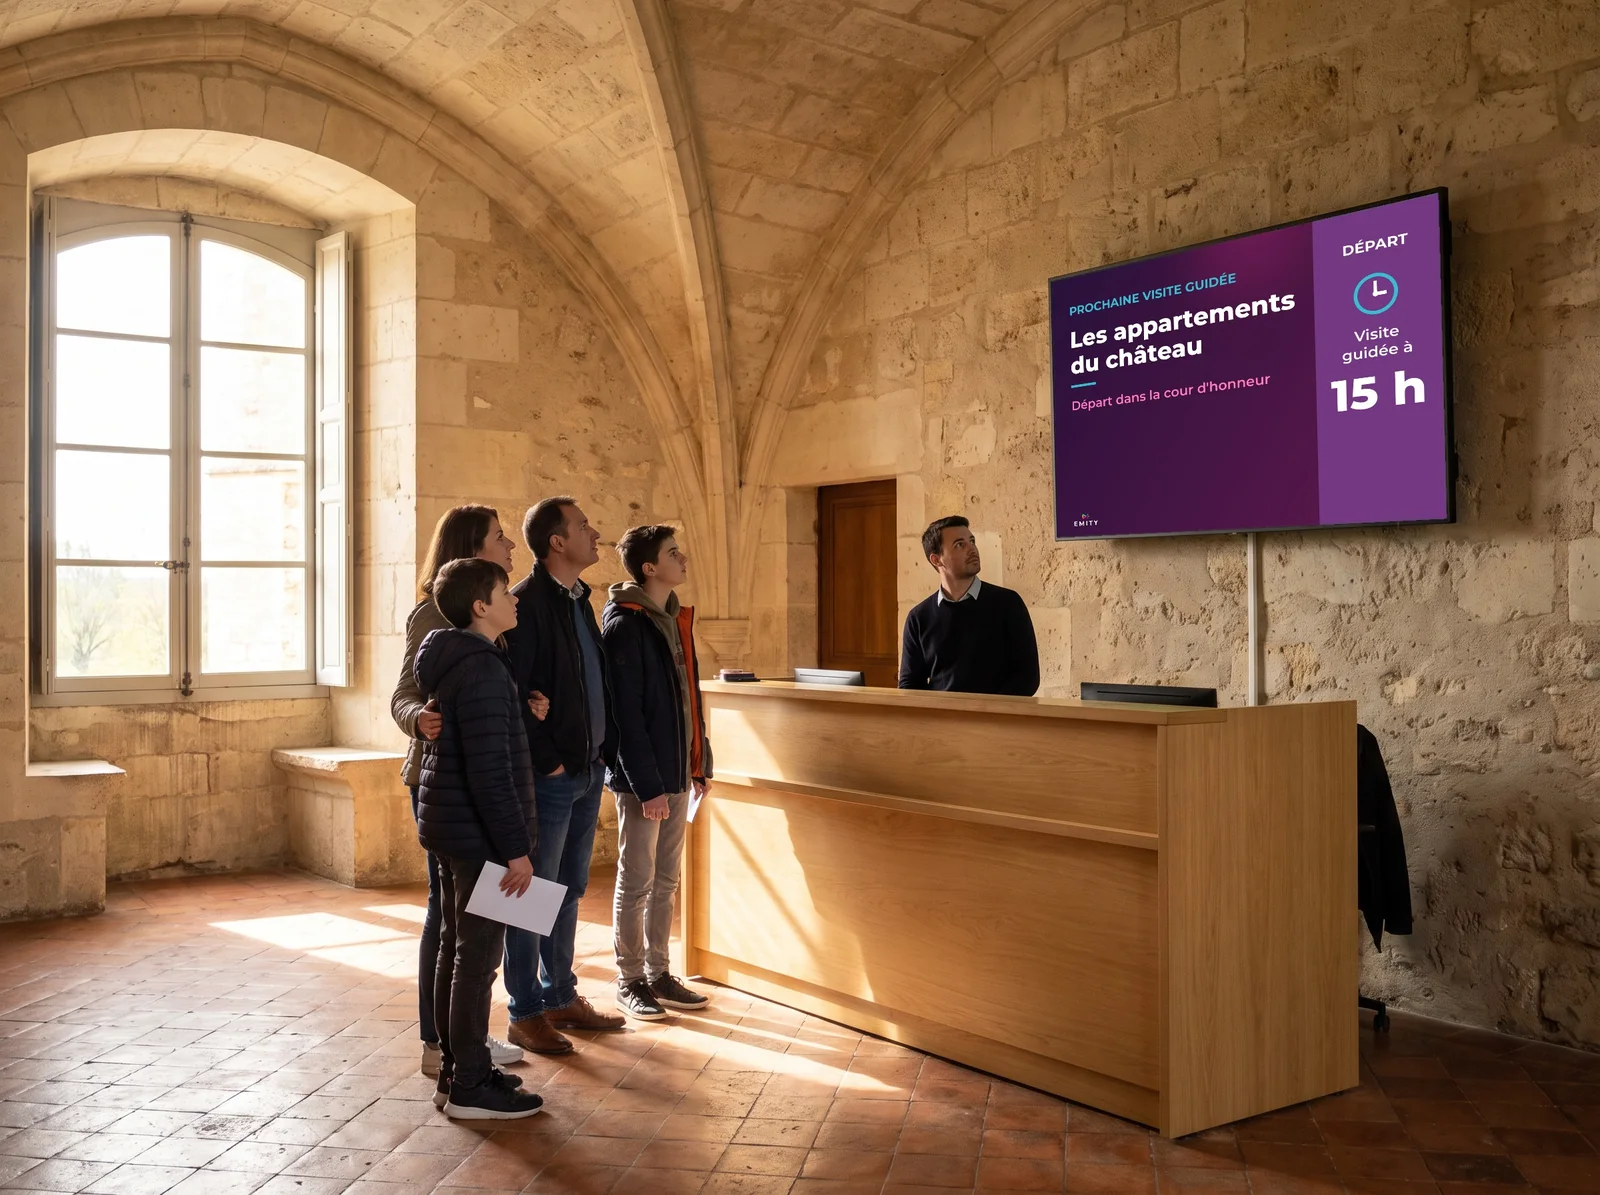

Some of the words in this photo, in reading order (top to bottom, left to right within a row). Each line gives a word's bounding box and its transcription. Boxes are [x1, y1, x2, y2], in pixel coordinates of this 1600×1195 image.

[1342, 232, 1408, 257] DÉPART
[1069, 292, 1140, 316] PROCHAINE
[1143, 284, 1182, 301] VISITE
[1184, 272, 1237, 292] GUIDÉE
[1070, 329, 1107, 349] Les
[1113, 294, 1296, 341] appartements
[1354, 325, 1400, 342] Visite
[1070, 354, 1099, 375] du
[1105, 339, 1202, 369] château
[1342, 342, 1399, 365] guidée
[1403, 340, 1413, 353] à
[1071, 396, 1113, 412] Départ
[1115, 393, 1147, 405] dans
[1149, 388, 1160, 401] la
[1163, 386, 1194, 399] cour
[1197, 375, 1271, 394] d'honneur
[1330, 375, 1380, 412] 15
[1394, 370, 1425, 405] h
[1073, 519, 1099, 527] EMITY
